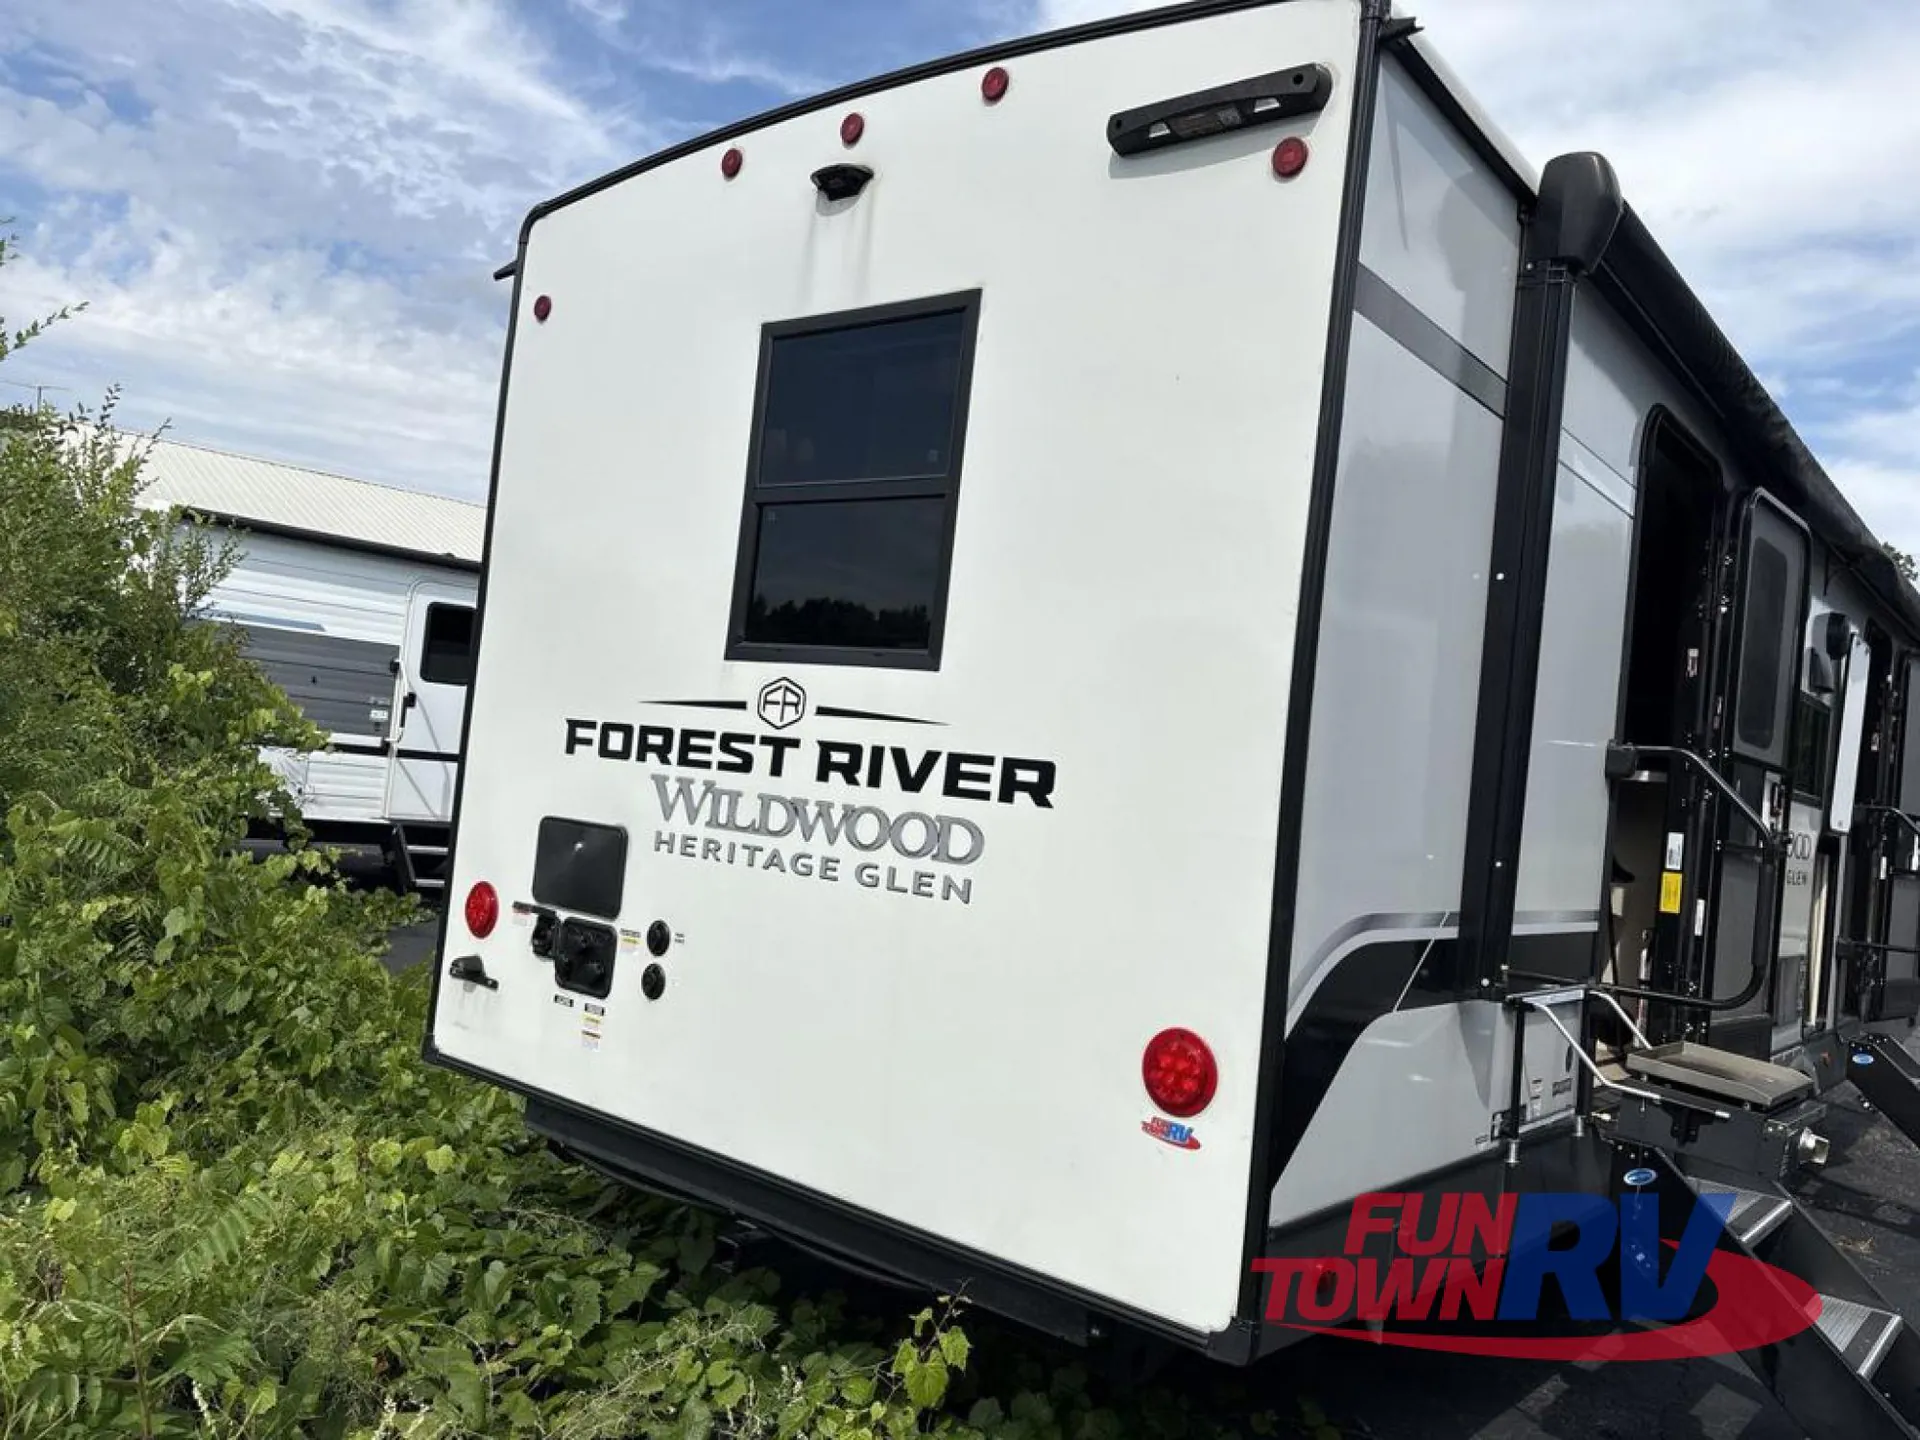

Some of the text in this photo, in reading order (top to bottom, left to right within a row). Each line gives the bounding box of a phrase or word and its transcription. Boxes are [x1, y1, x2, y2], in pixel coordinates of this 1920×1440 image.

[564, 718, 1057, 808] FOREST RIVER
[650, 774, 986, 866] WILDWOOD
[653, 830, 974, 905] HERITAGE GLEN
